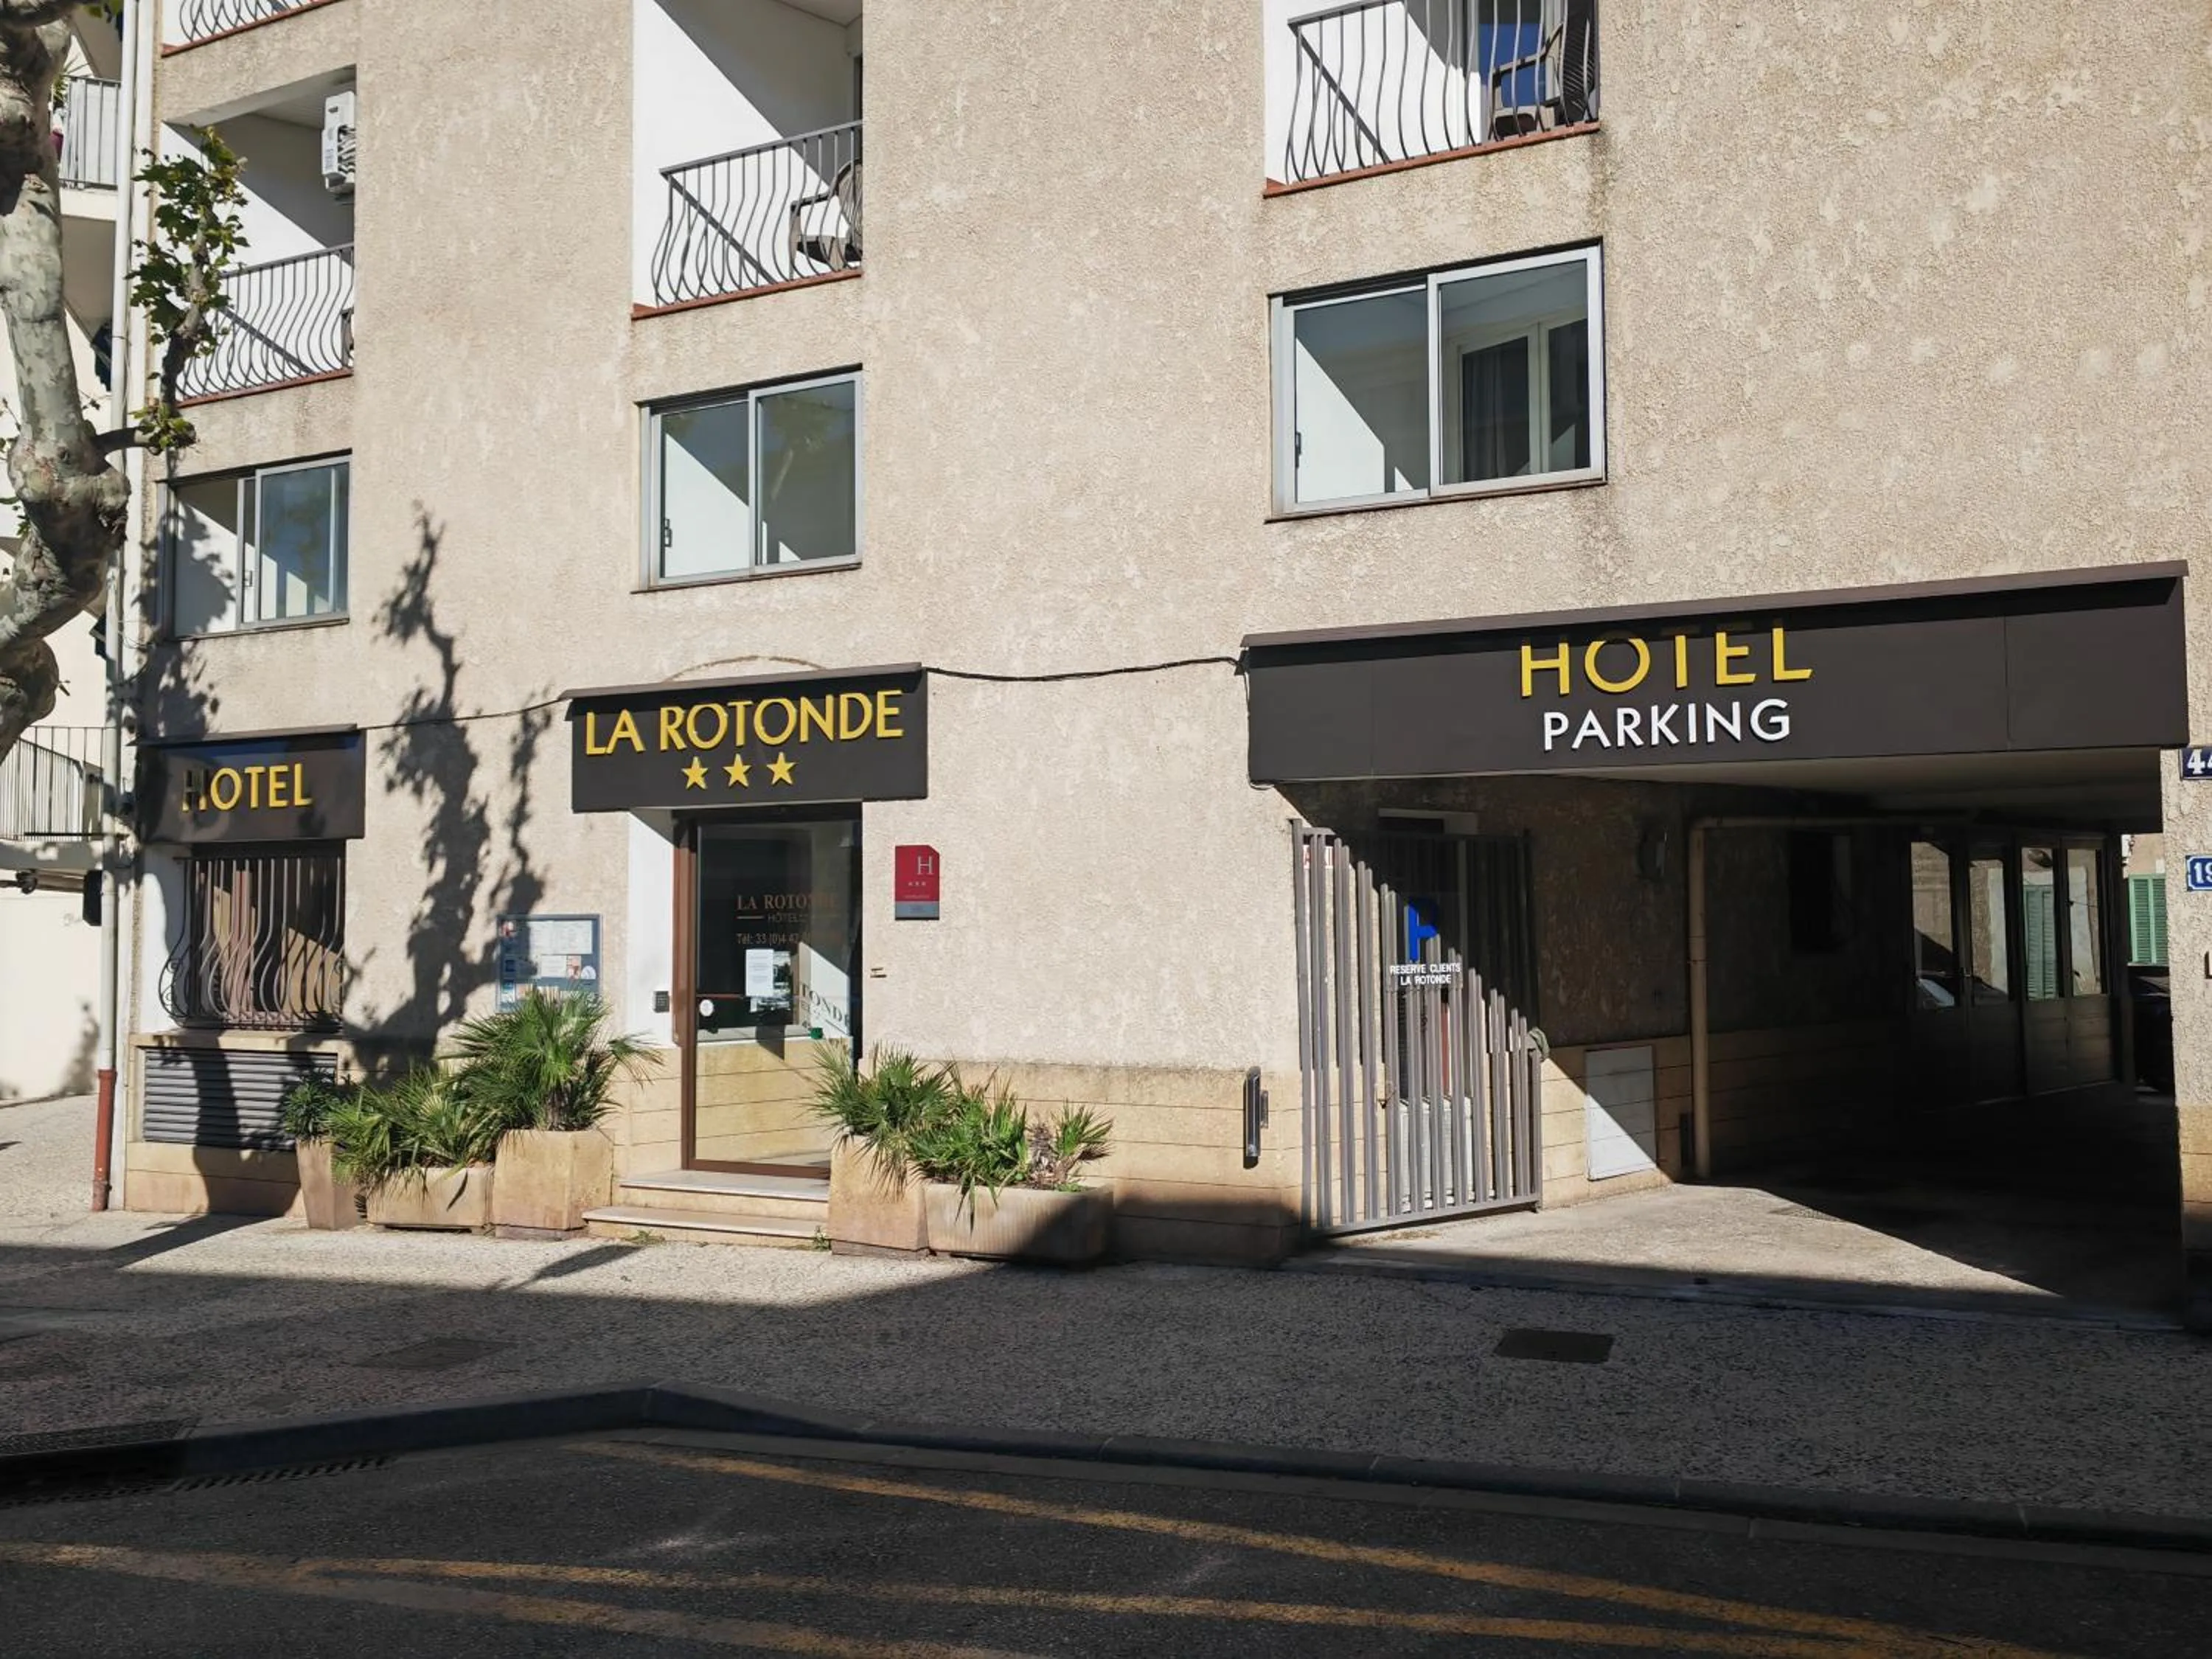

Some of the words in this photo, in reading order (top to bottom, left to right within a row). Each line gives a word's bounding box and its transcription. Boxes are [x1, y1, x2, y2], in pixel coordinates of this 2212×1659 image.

[1520, 618, 1813, 697] HOTEL
[585, 709, 646, 755] LA
[660, 690, 905, 752] ROTONDE
[1543, 698, 1790, 751] PARKING
[2187, 747, 2212, 775] 4
[181, 763, 313, 813] HOTEL
[917, 855, 934, 875] H
[737, 894, 757, 910] LA
[763, 893, 835, 910] ROTO
[1400, 975, 1411, 986] LA
[1414, 975, 1451, 984] ROTONDE
[1430, 962, 1461, 973] CLIENTS
